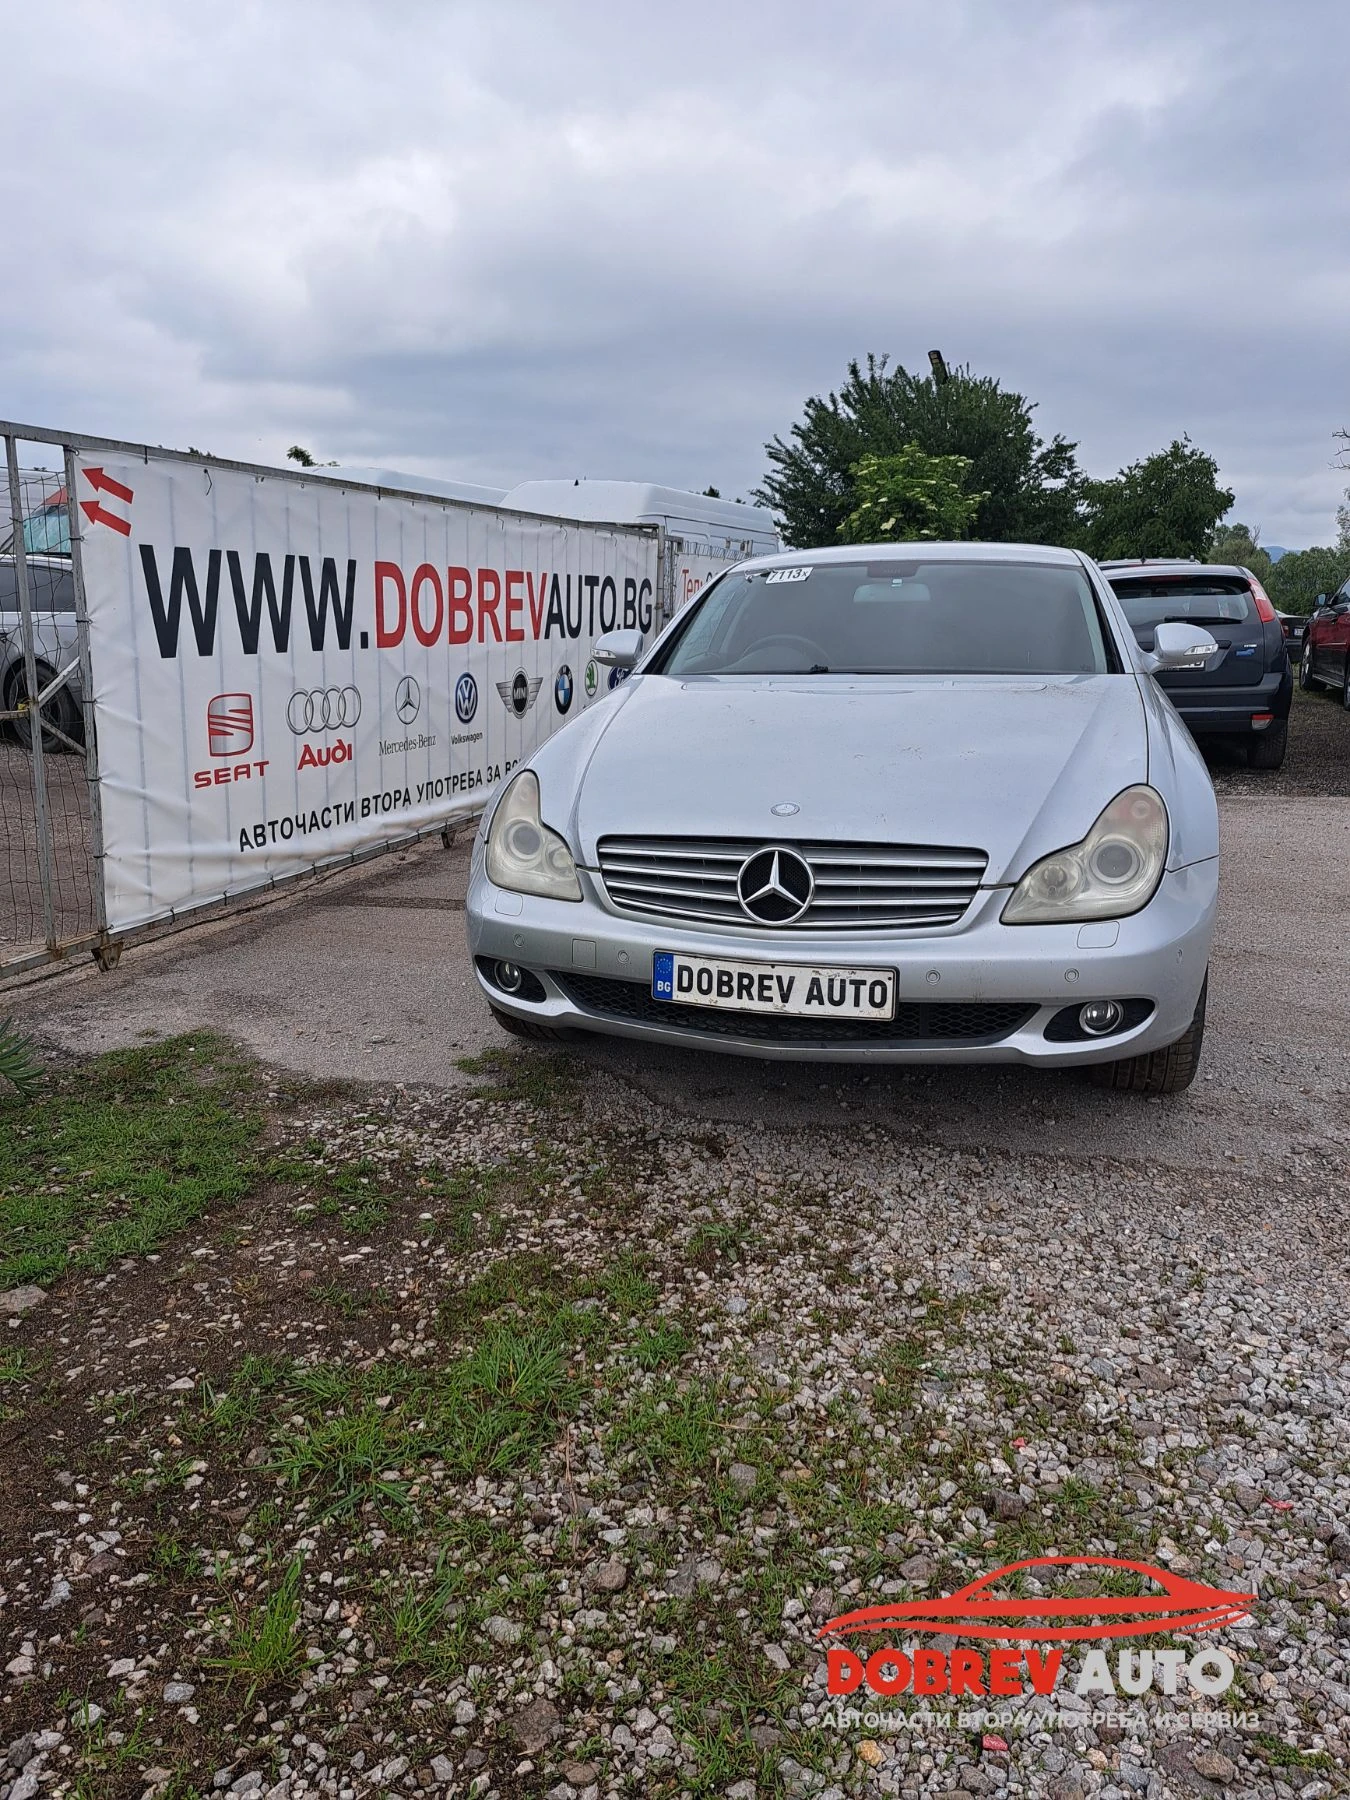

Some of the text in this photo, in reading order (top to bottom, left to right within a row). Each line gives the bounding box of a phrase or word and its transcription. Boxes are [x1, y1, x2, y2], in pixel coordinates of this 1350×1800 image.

[139, 544, 652, 658] WWW.DOBREVAUTO.BG
[378, 734, 436, 756] Mercedes-Benz
[451, 732, 483, 745] Volkswagen
[297, 739, 352, 770] Audi
[194, 760, 269, 788] SEAT
[239, 801, 354, 852] АВТОЧАСТИ
[361, 787, 411, 817] ВТОРА
[416, 769, 482, 803] УПОТРЕБА
[486, 764, 501, 784] ЗА
[657, 980, 671, 992] BG
[677, 965, 887, 1008] DOBREV AUTO
